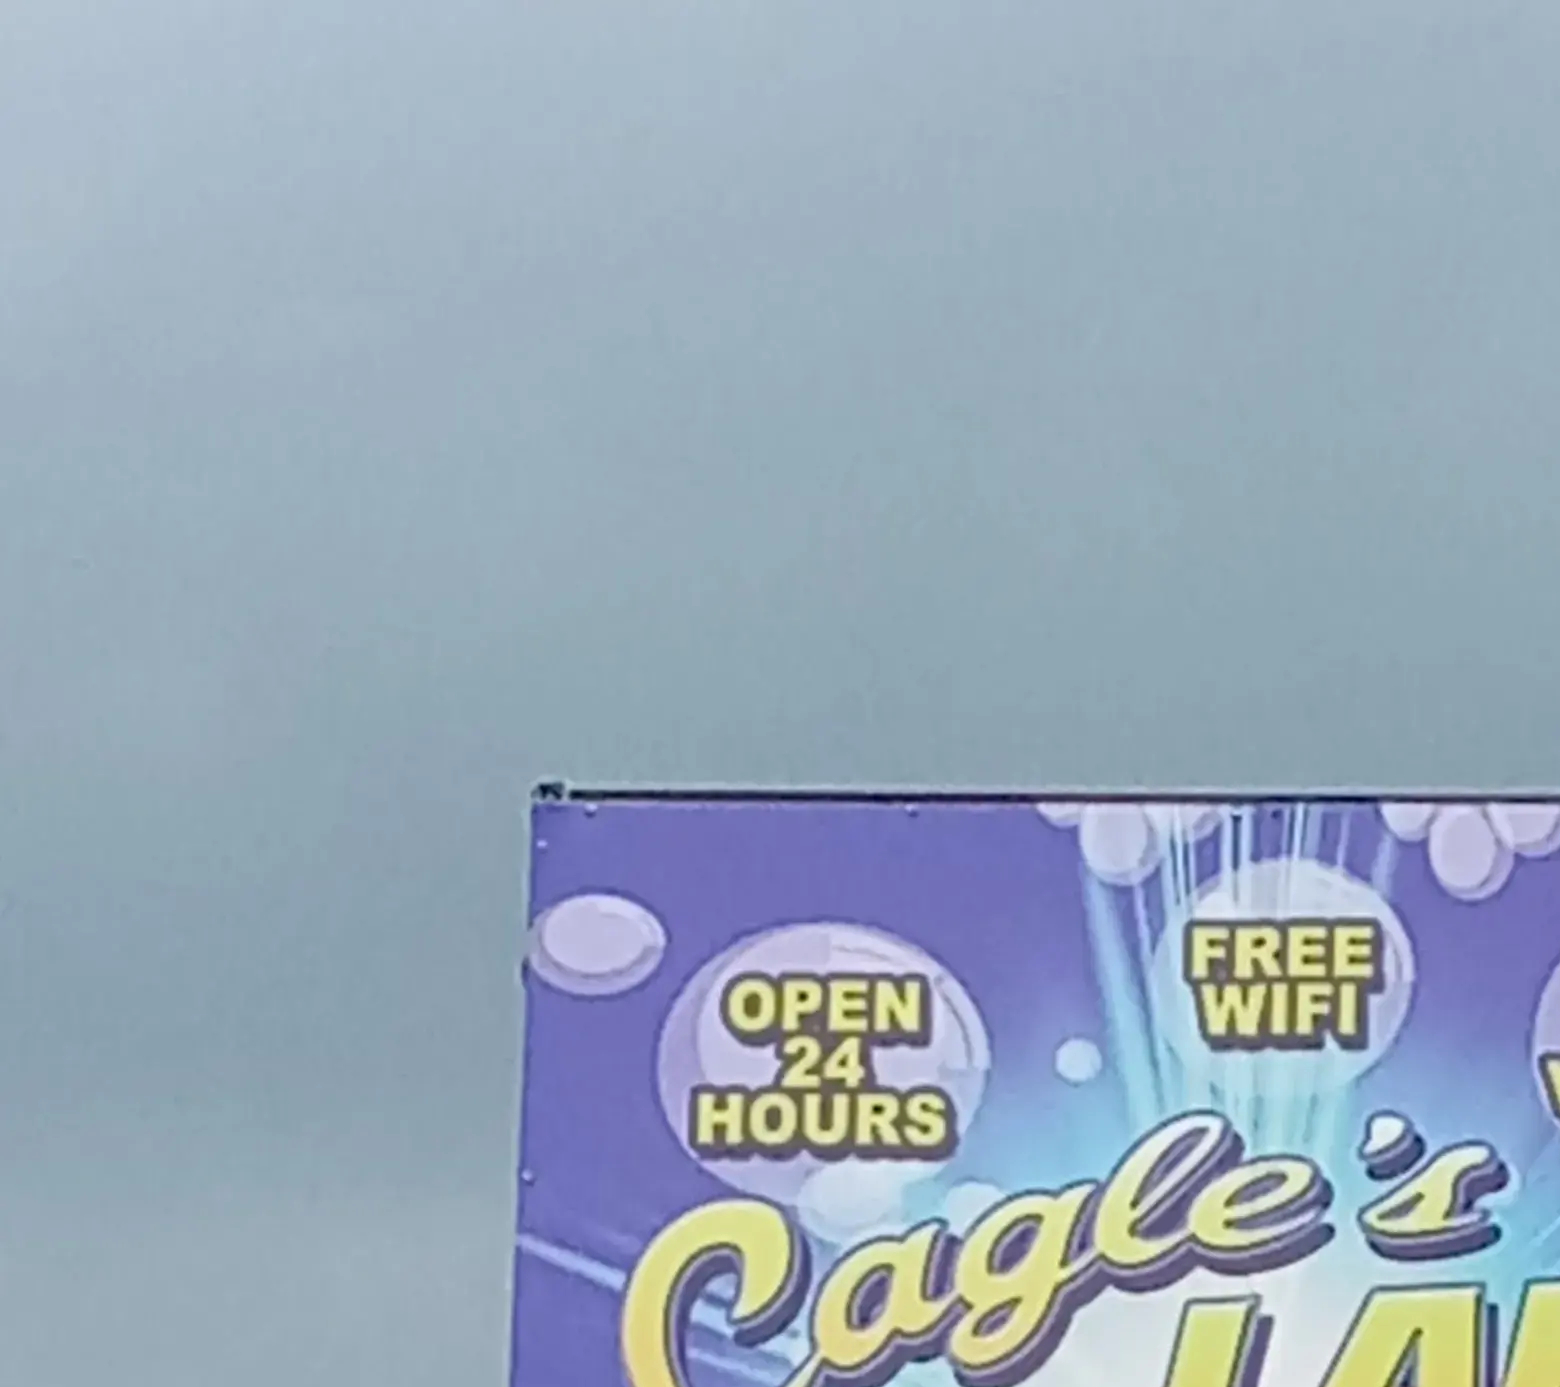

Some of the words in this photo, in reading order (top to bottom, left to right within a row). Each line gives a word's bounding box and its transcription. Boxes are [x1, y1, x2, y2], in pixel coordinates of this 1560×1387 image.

[1187, 922, 1377, 982] FREE
[722, 977, 924, 1035] OPEN
[1198, 986, 1364, 1040] WIFI
[779, 1036, 868, 1091] 24
[694, 1090, 951, 1149] HOURS
